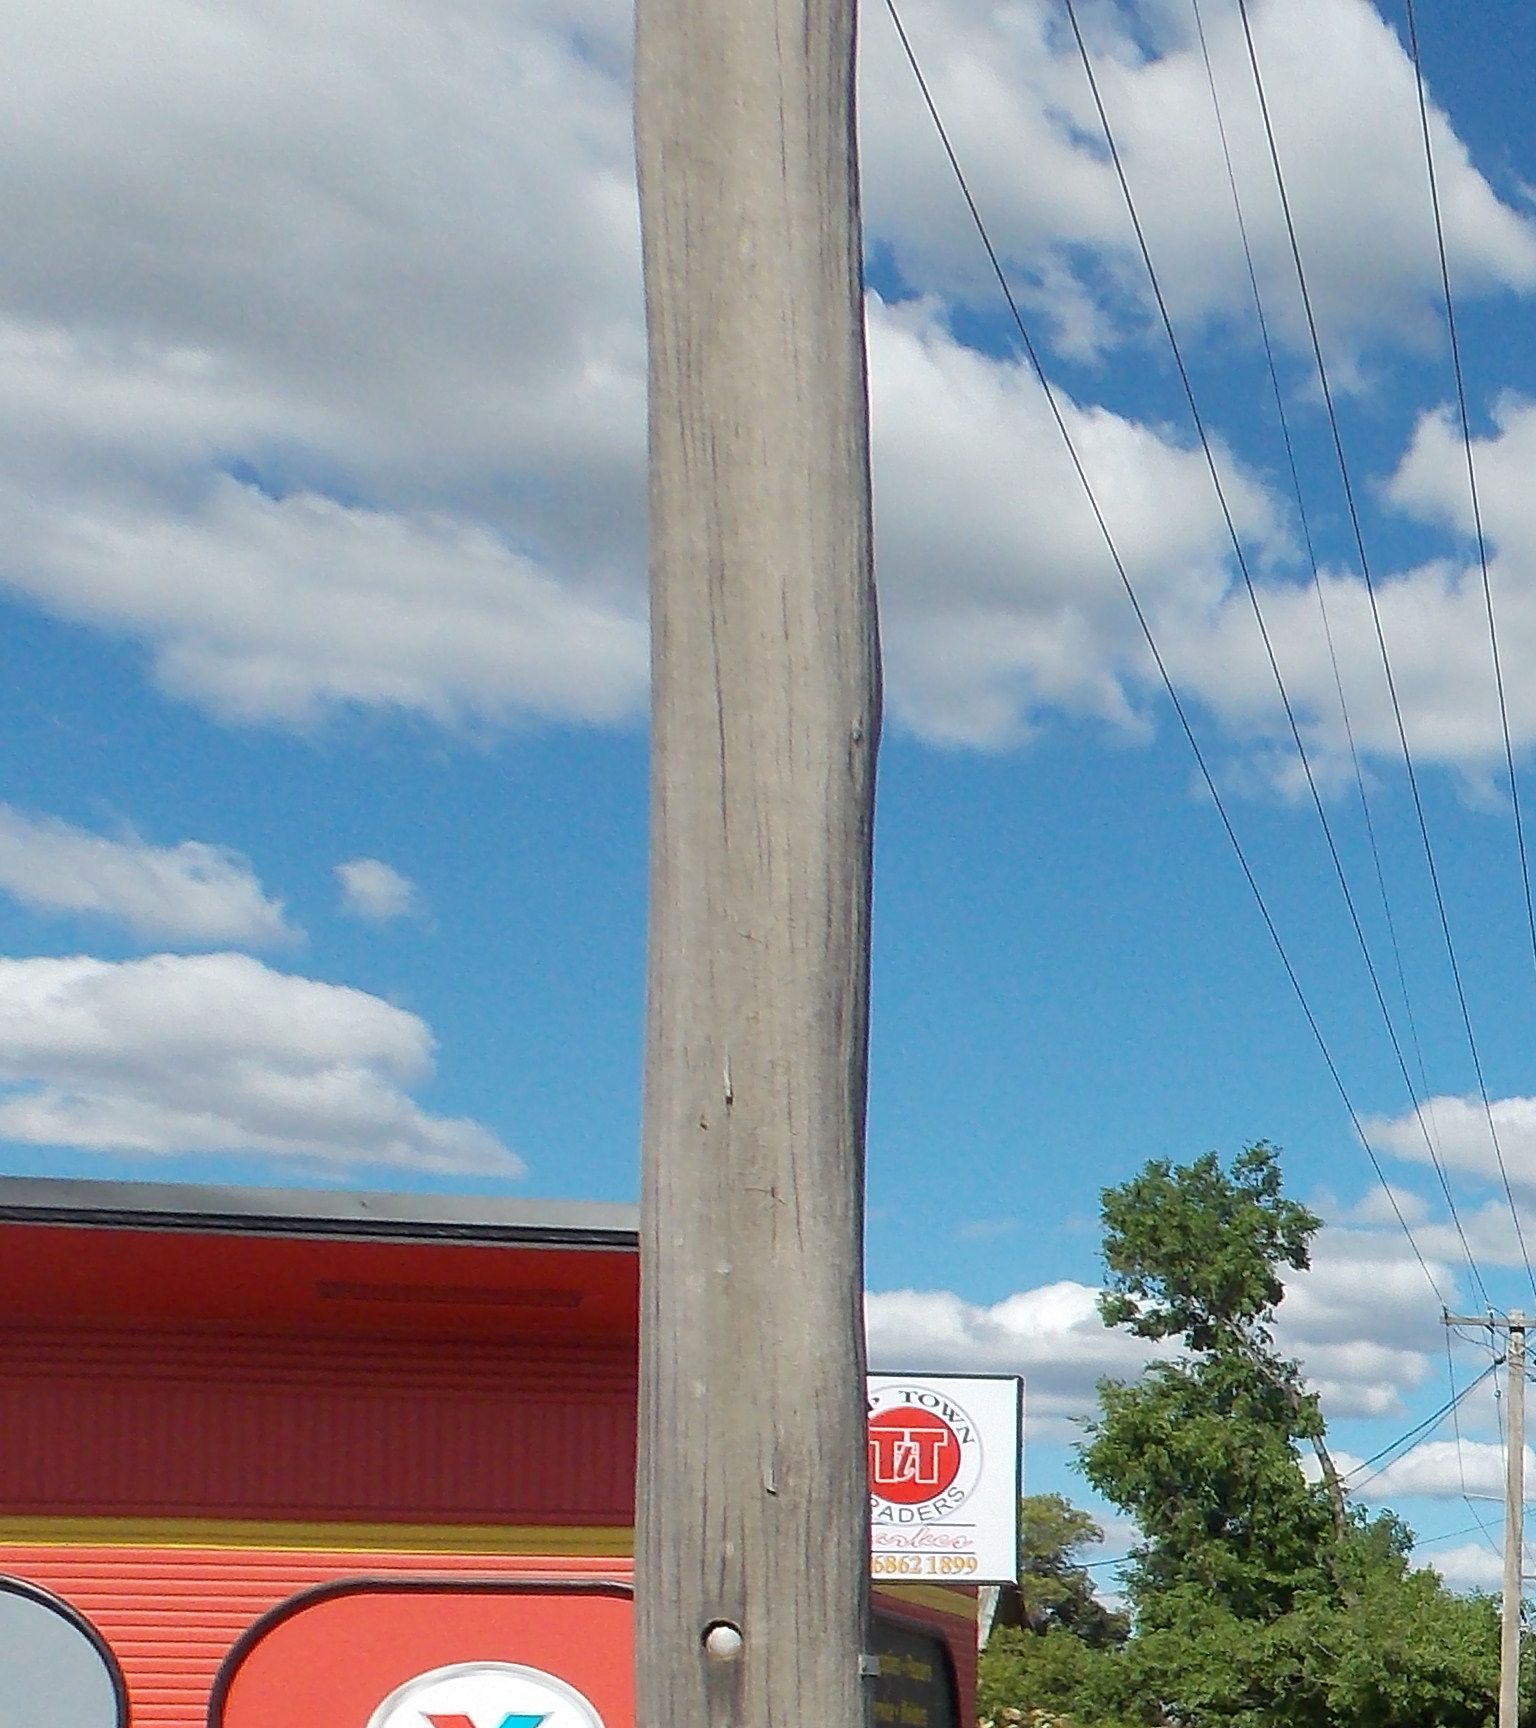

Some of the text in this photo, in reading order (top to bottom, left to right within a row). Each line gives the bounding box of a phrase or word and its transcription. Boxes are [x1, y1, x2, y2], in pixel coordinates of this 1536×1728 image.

[898, 1390, 976, 1444] TOWN
[871, 1486, 965, 1523] ADERS
[925, 1555, 979, 1575] 1899
